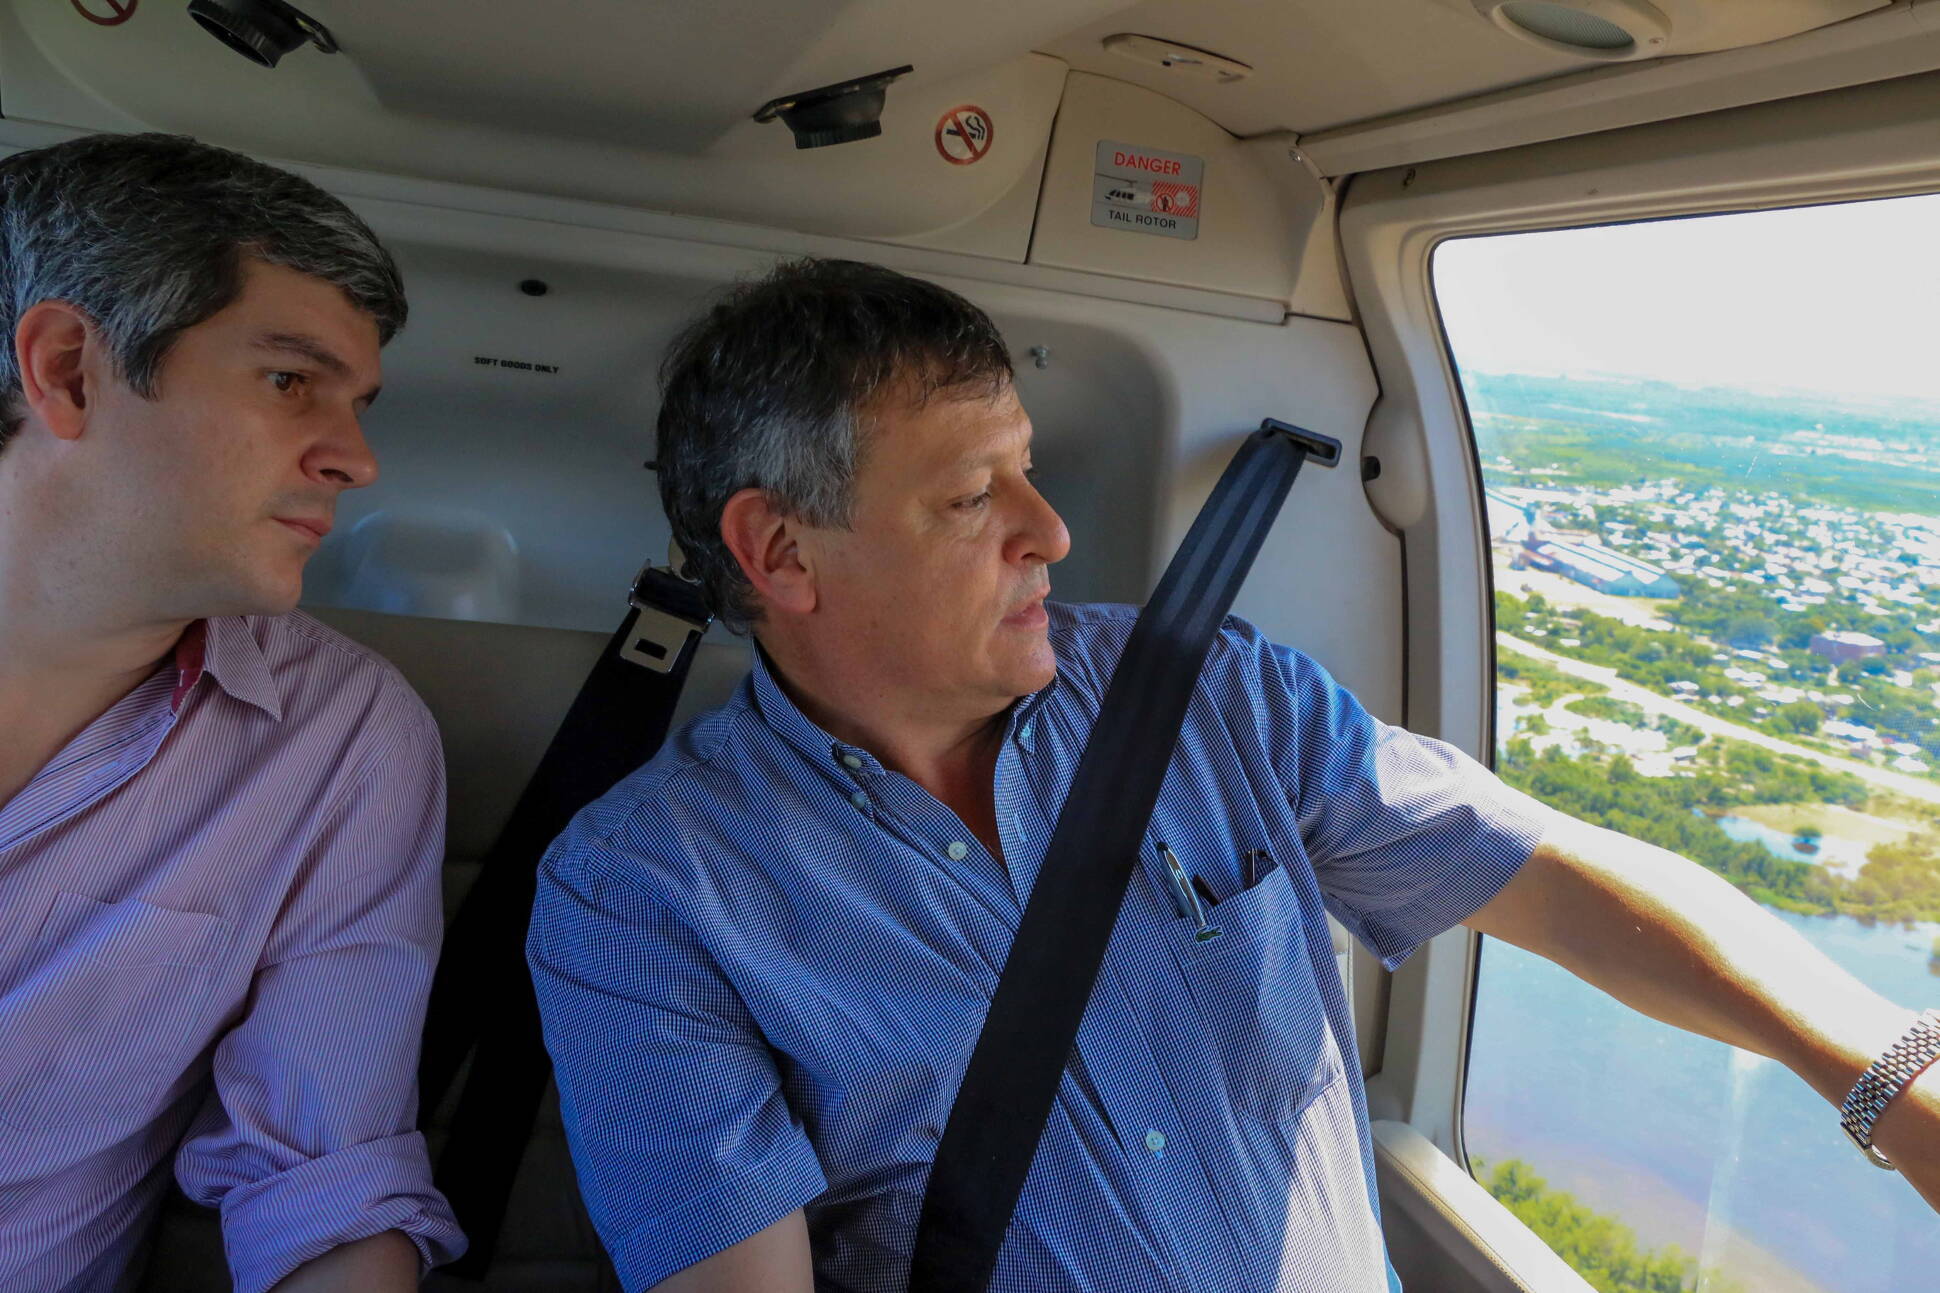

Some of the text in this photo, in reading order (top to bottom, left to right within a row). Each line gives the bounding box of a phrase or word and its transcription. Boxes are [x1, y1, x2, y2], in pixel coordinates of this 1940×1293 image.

[1114, 152, 1181, 175] DANGER
[1109, 210, 1177, 229] TAIL ROTOR
[474, 357, 559, 374] SOFT GOODS ONLY
